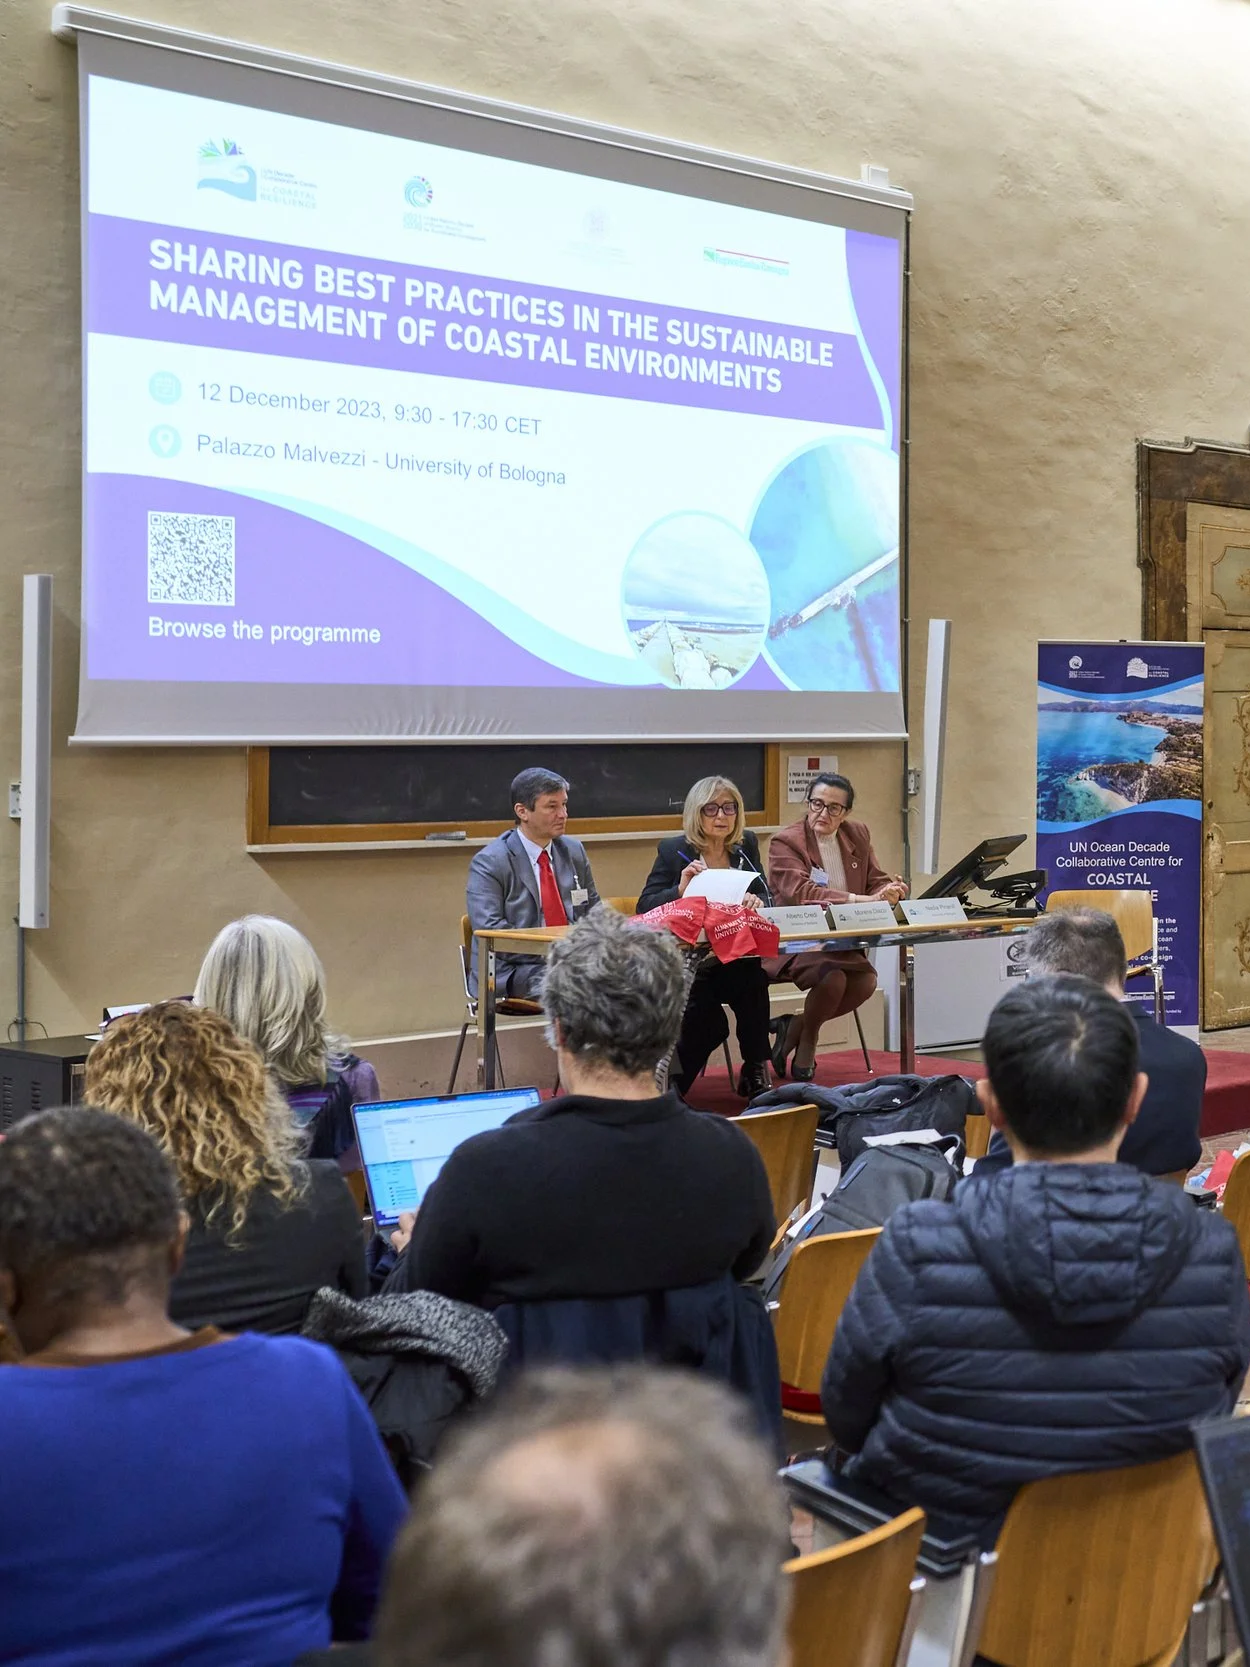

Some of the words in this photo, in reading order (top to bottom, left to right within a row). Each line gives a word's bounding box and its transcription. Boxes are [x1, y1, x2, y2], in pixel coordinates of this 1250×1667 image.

[149, 238, 304, 290] SHARING
[314, 264, 395, 302] BEST
[404, 279, 565, 328] PRACTICES
[573, 303, 600, 334] IN
[608, 309, 659, 342] THE
[666, 319, 834, 368] SUSTAINABLE
[149, 280, 387, 341] MANAGEMENT
[397, 316, 436, 347] OF
[445, 323, 577, 366] COASTAL
[585, 343, 782, 394] ENVIRONMENTS
[198, 382, 222, 402] 12
[229, 385, 331, 413] December
[336, 397, 387, 423] 2023,
[394, 403, 432, 425] 9:30
[452, 411, 498, 431] 17:30
[505, 416, 542, 436] CET
[197, 434, 276, 459] Palazzo
[283, 442, 366, 467] Malvezzi
[385, 451, 472, 481] University
[477, 462, 494, 479] of
[500, 462, 567, 487] Bologna
[148, 616, 227, 639] Browse
[232, 619, 264, 640] the
[270, 624, 382, 646] programme
[1055, 856, 1126, 868] Collaborative
[1128, 856, 1166, 867] Centre
[1168, 855, 1184, 867] for
[1069, 842, 1088, 853] UN
[1090, 841, 1125, 853] Ocean
[1128, 841, 1171, 852] Decade
[1086, 873, 1152, 886] COASTAL
